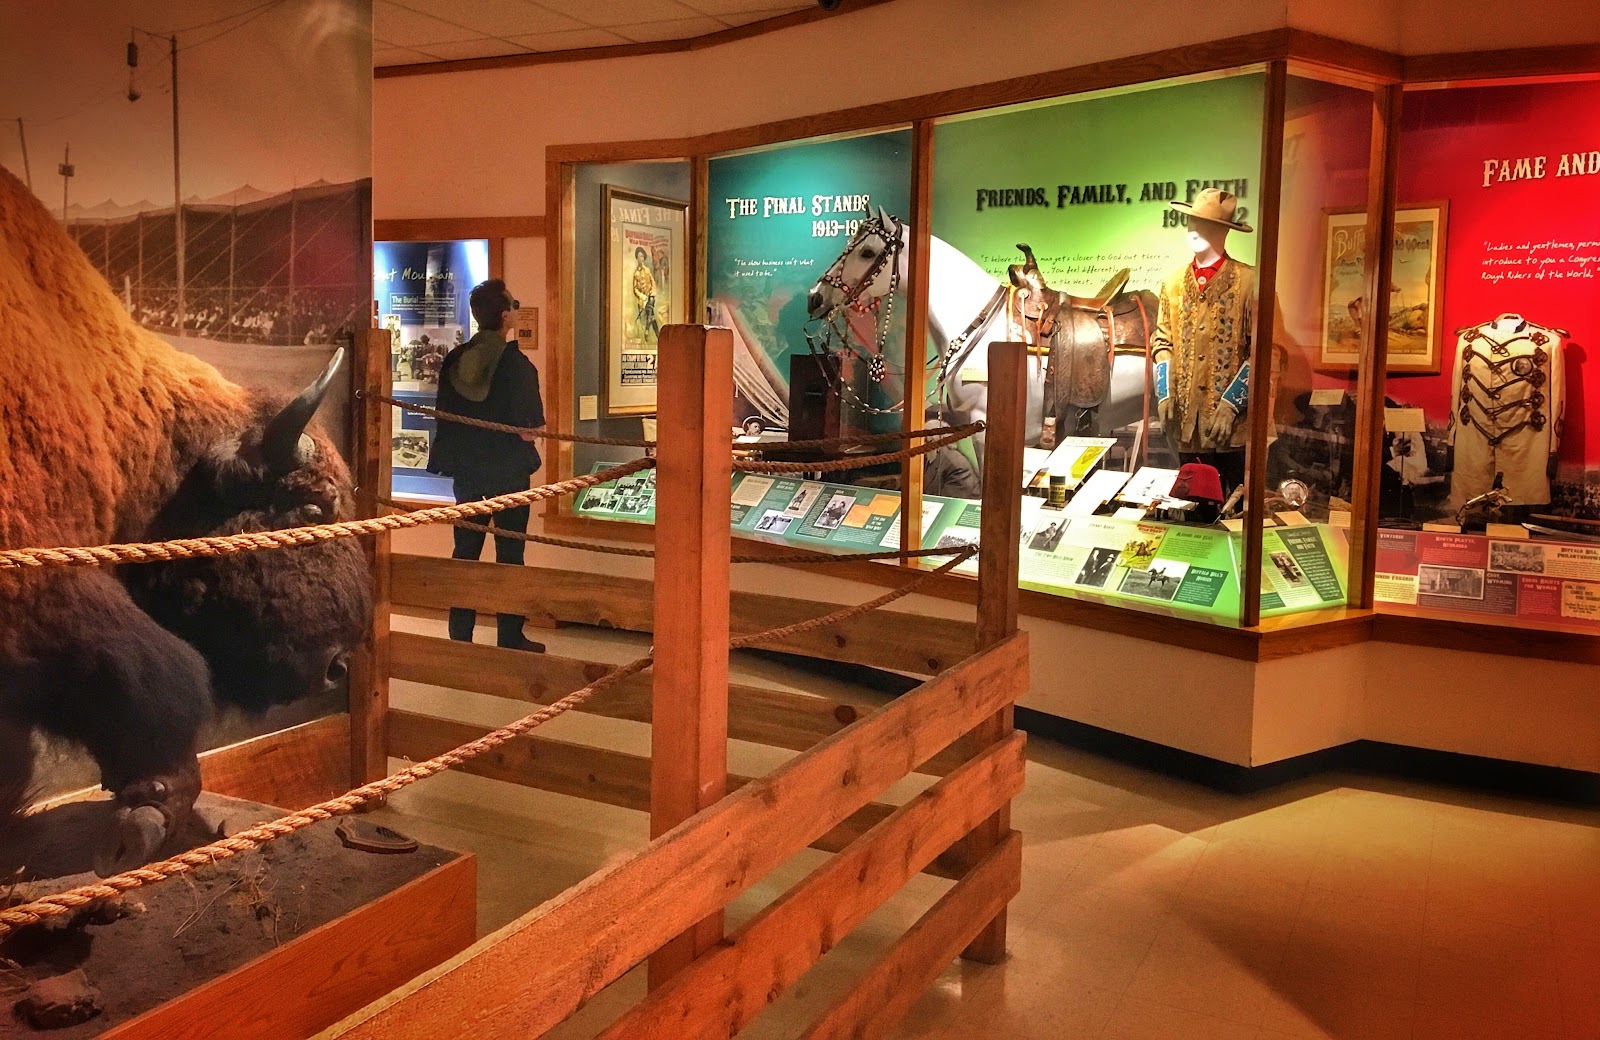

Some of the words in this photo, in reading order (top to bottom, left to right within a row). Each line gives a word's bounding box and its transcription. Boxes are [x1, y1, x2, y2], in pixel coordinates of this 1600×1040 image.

[1482, 156, 1547, 187] FAME
[1555, 150, 1600, 177] AND
[976, 188, 1049, 211] FRIENDS,
[1057, 184, 1131, 208] FAMILY,
[1139, 181, 1177, 201] AND
[725, 197, 758, 219] THE
[763, 196, 806, 218] FINAL
[811, 194, 870, 216] STANDS
[811, 219, 864, 237] 1913-19
[1516, 241, 1530, 250] and
[1014, 254, 1026, 262] tha
[1482, 257, 1522, 267] introduce
[1526, 256, 1538, 266] to
[1538, 257, 1556, 270] you
[402, 267, 454, 281] Mouain
[1481, 271, 1505, 285] Rough
[1534, 269, 1546, 280] of
[1548, 269, 1564, 280] the
